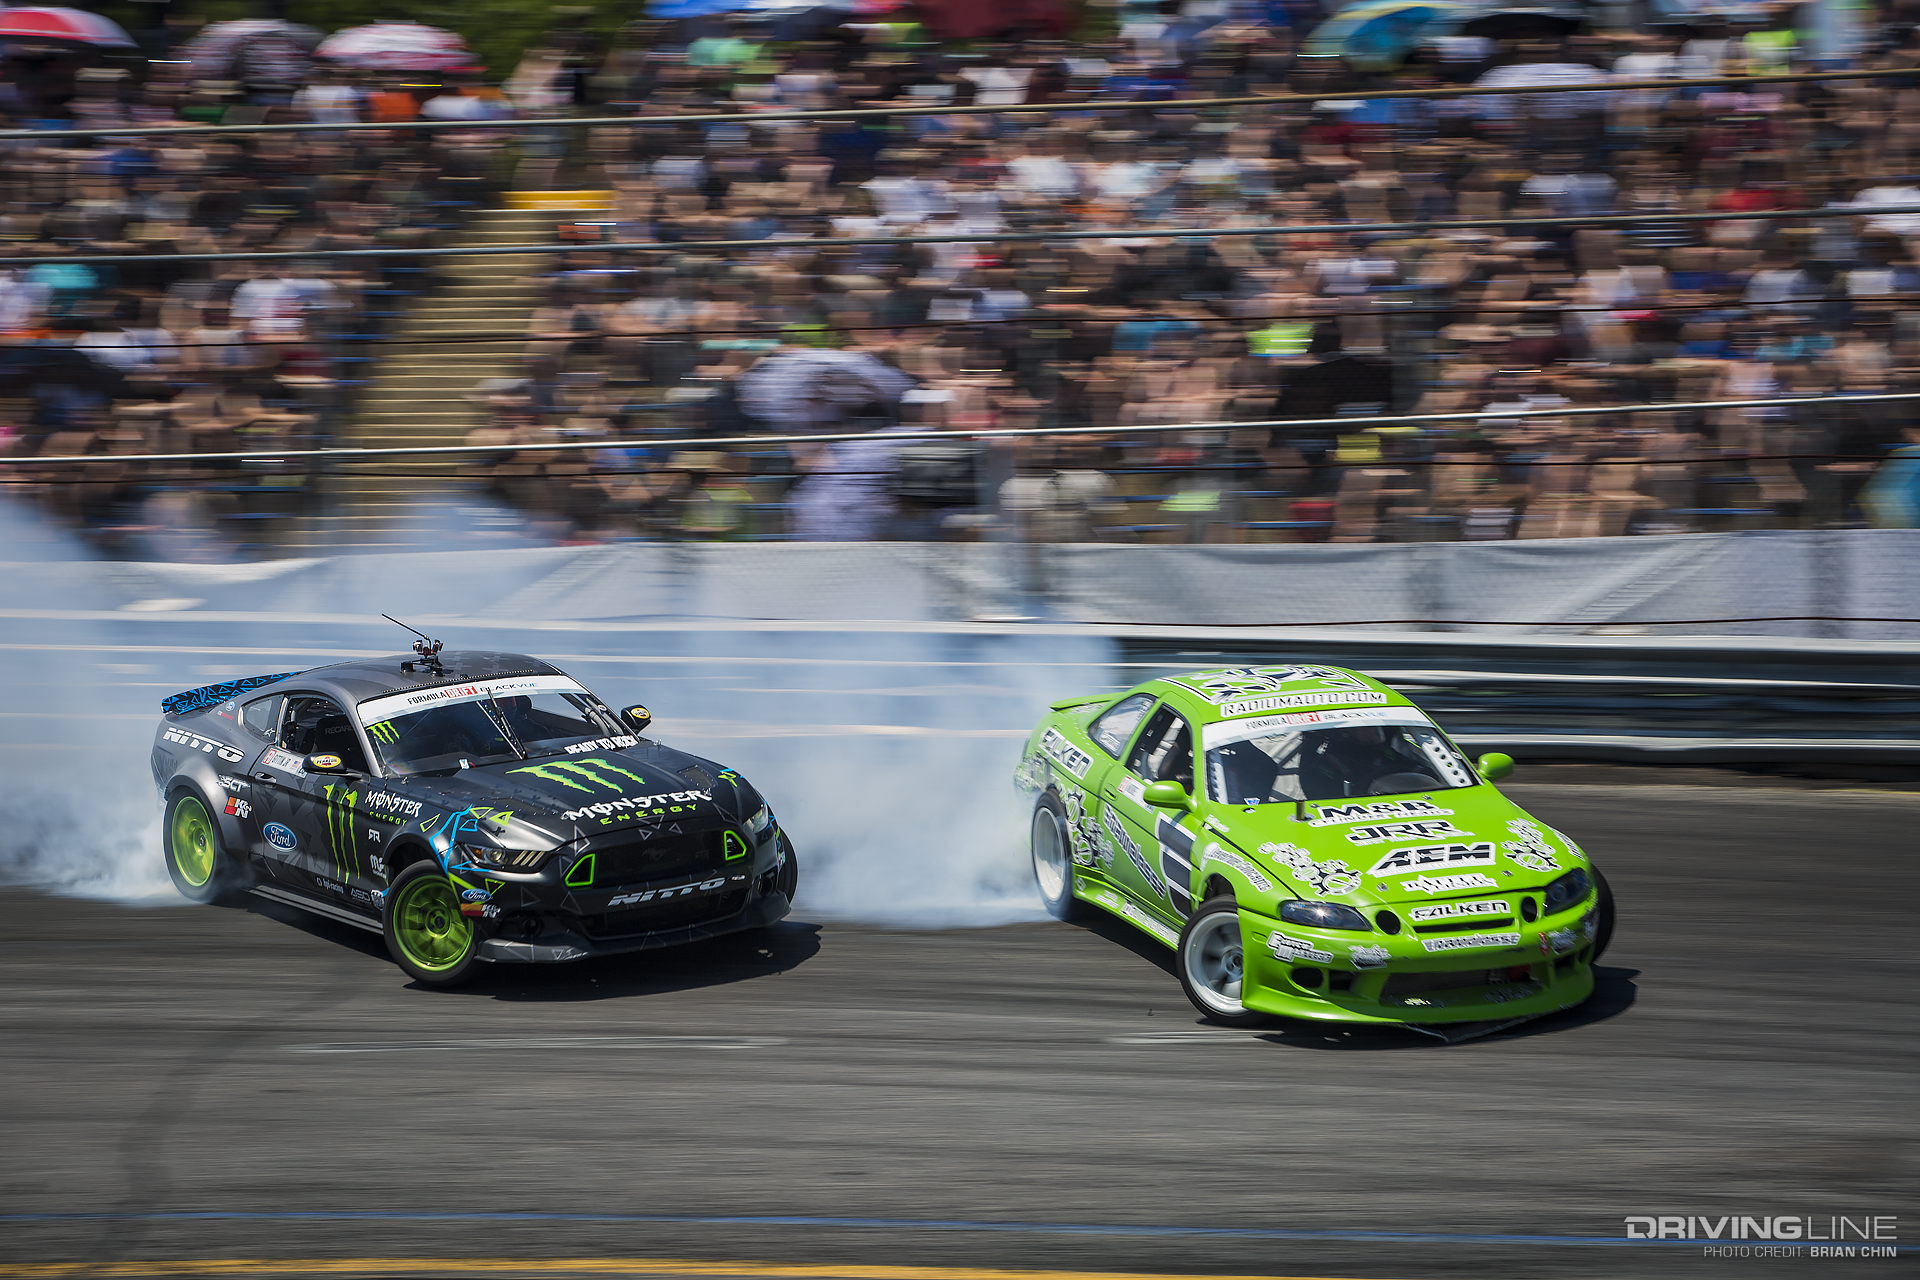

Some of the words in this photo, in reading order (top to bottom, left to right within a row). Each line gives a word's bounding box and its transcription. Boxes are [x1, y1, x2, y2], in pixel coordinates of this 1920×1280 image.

[407, 692, 446, 705] FORMULA
[445, 686, 478, 698] DRIFT
[1223, 692, 1384, 716] RADIUMAUTO.COM
[1246, 717, 1287, 730] FORMULA
[1286, 712, 1321, 724] DRIFT
[163, 727, 245, 763] NITTO
[1042, 729, 1090, 779] FALKEN
[365, 790, 423, 818] MONSTER
[565, 789, 712, 821] MONSTER
[600, 804, 697, 825] ENERGY
[369, 811, 408, 826] ENERGY
[1377, 845, 1490, 870] AEM
[607, 877, 726, 907] NITTO
[1414, 901, 1509, 918] FALKEN
